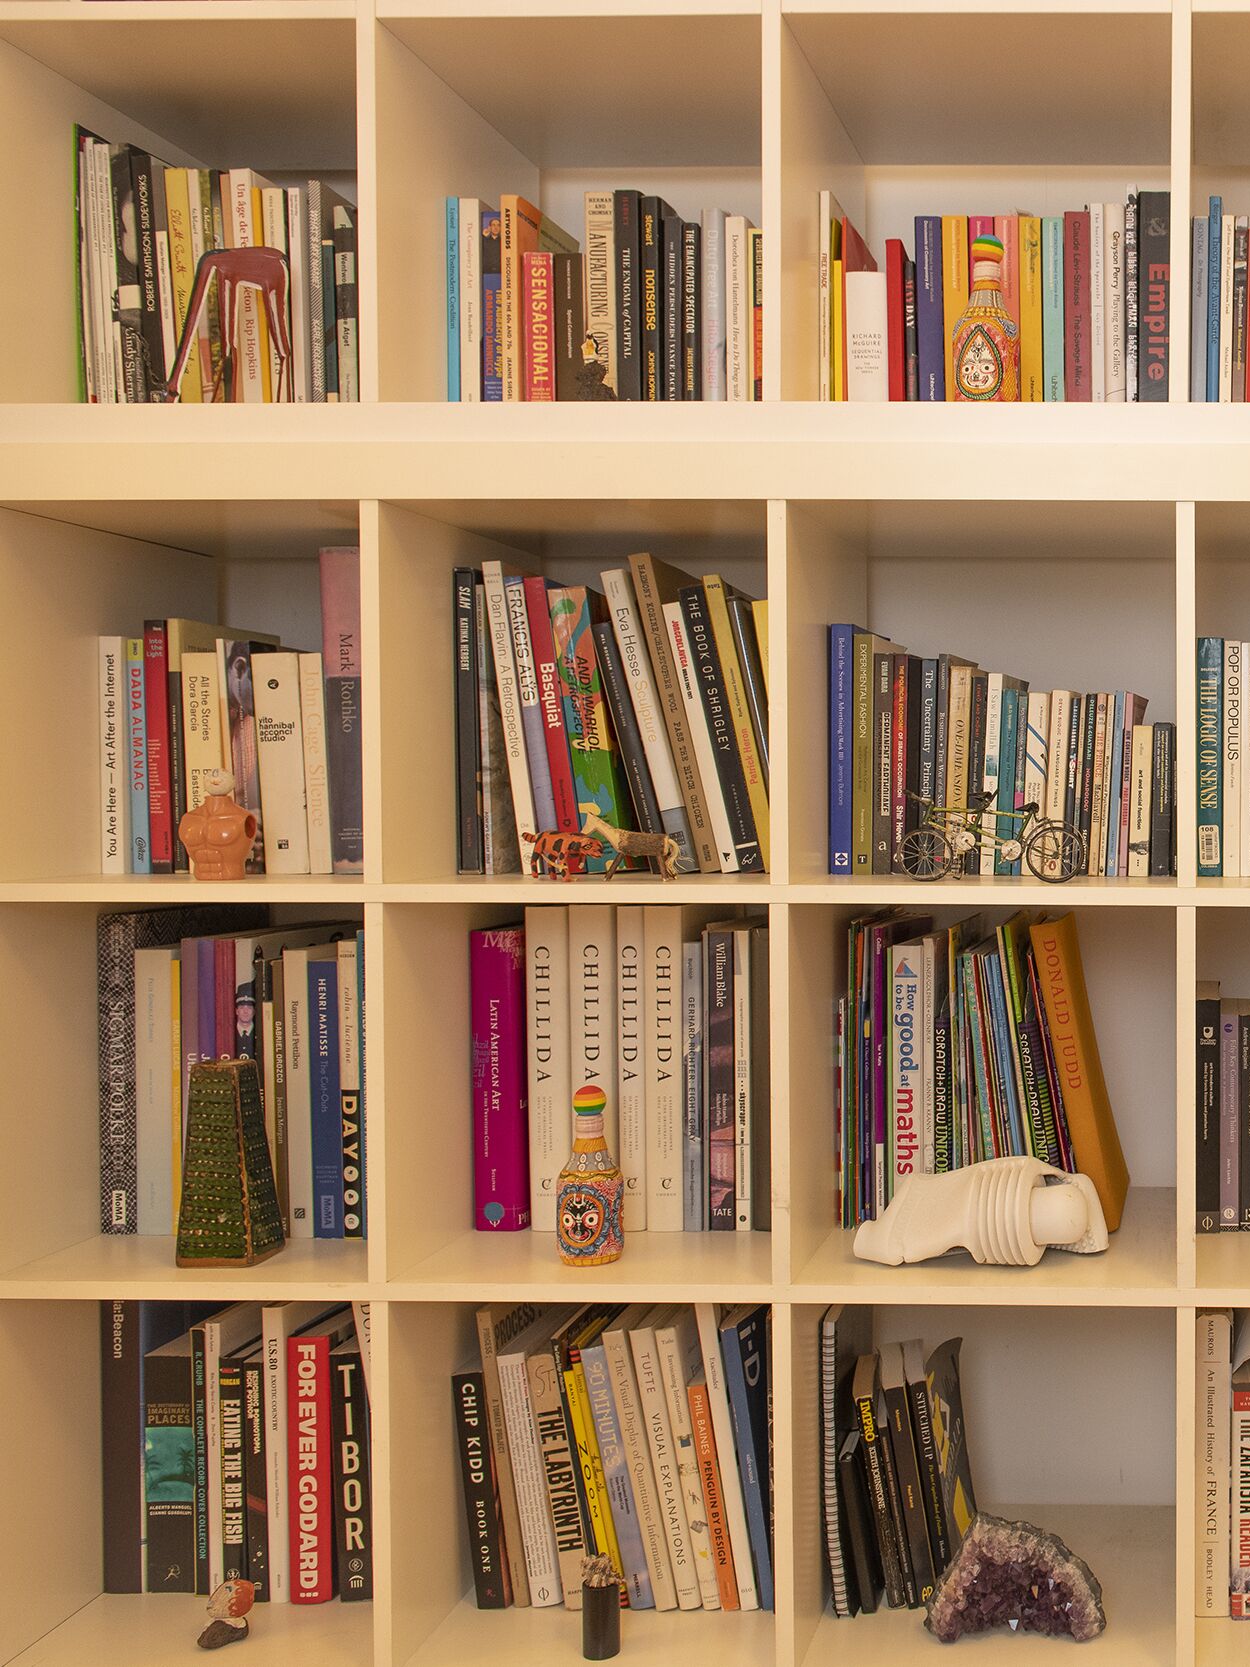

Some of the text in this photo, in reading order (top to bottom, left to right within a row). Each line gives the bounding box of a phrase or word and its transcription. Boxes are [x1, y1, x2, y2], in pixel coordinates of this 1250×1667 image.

[141, 231, 156, 312] ROBERT SMITHSON
[645, 269, 657, 331] nonsense
[685, 230, 695, 334] THE EMANCIPATED SPECTATOR
[1110, 231, 1122, 378] Grayson Perry Playing to the Gallery
[244, 319, 258, 380] Rip Hopkins
[531, 267, 548, 384] SENSACIONAL
[1146, 262, 1170, 382] Empire
[458, 586, 471, 609] SLAM
[508, 588, 537, 702] FRANCIS ALŸS
[615, 607, 641, 677] Eva Hesse
[339, 633, 355, 733] Mark Rothko
[539, 662, 562, 729] Basquiat
[687, 594, 731, 753] THE BOOK OF SHRIGLEY
[859, 643, 868, 738] EXPERIMENTAL FASHION
[1228, 645, 1239, 760] POP OR POPULUS
[130, 668, 145, 791] DADA ALMANAC
[1136, 808, 1144, 830] function
[318, 978, 329, 1057] HENRI MATISSE
[535, 946, 551, 1083] CHILLIDA
[583, 944, 600, 1082] CHILLIDA
[621, 946, 638, 1083] CHILLIDA
[656, 946, 672, 1083] CHILLIDA
[716, 942, 726, 1007] William Blake
[895, 984, 905, 1011] to be
[906, 984, 917, 1011] How
[1043, 939, 1082, 1090] DONALD JUDD
[108, 1000, 125, 1074] SIGMAR
[289, 1000, 301, 1070] Raymond Pettibon
[109, 1080, 126, 1147] POLKE
[896, 1013, 919, 1176] good at maths
[115, 1192, 124, 1222] MoMA
[297, 1344, 316, 1397] FOR
[223, 1399, 243, 1544] EATING THE BIG FISH
[298, 1402, 317, 1471] EVER
[337, 1364, 365, 1550] TIBOR
[859, 1400, 886, 1509] IMPRO KEITH JOHNSTONE
[915, 1392, 934, 1460] STITCHED UP
[461, 1383, 491, 1573] CHIP KIDD BOOK ONE
[704, 1460, 726, 1566] PENGUIN BY DESIGN
